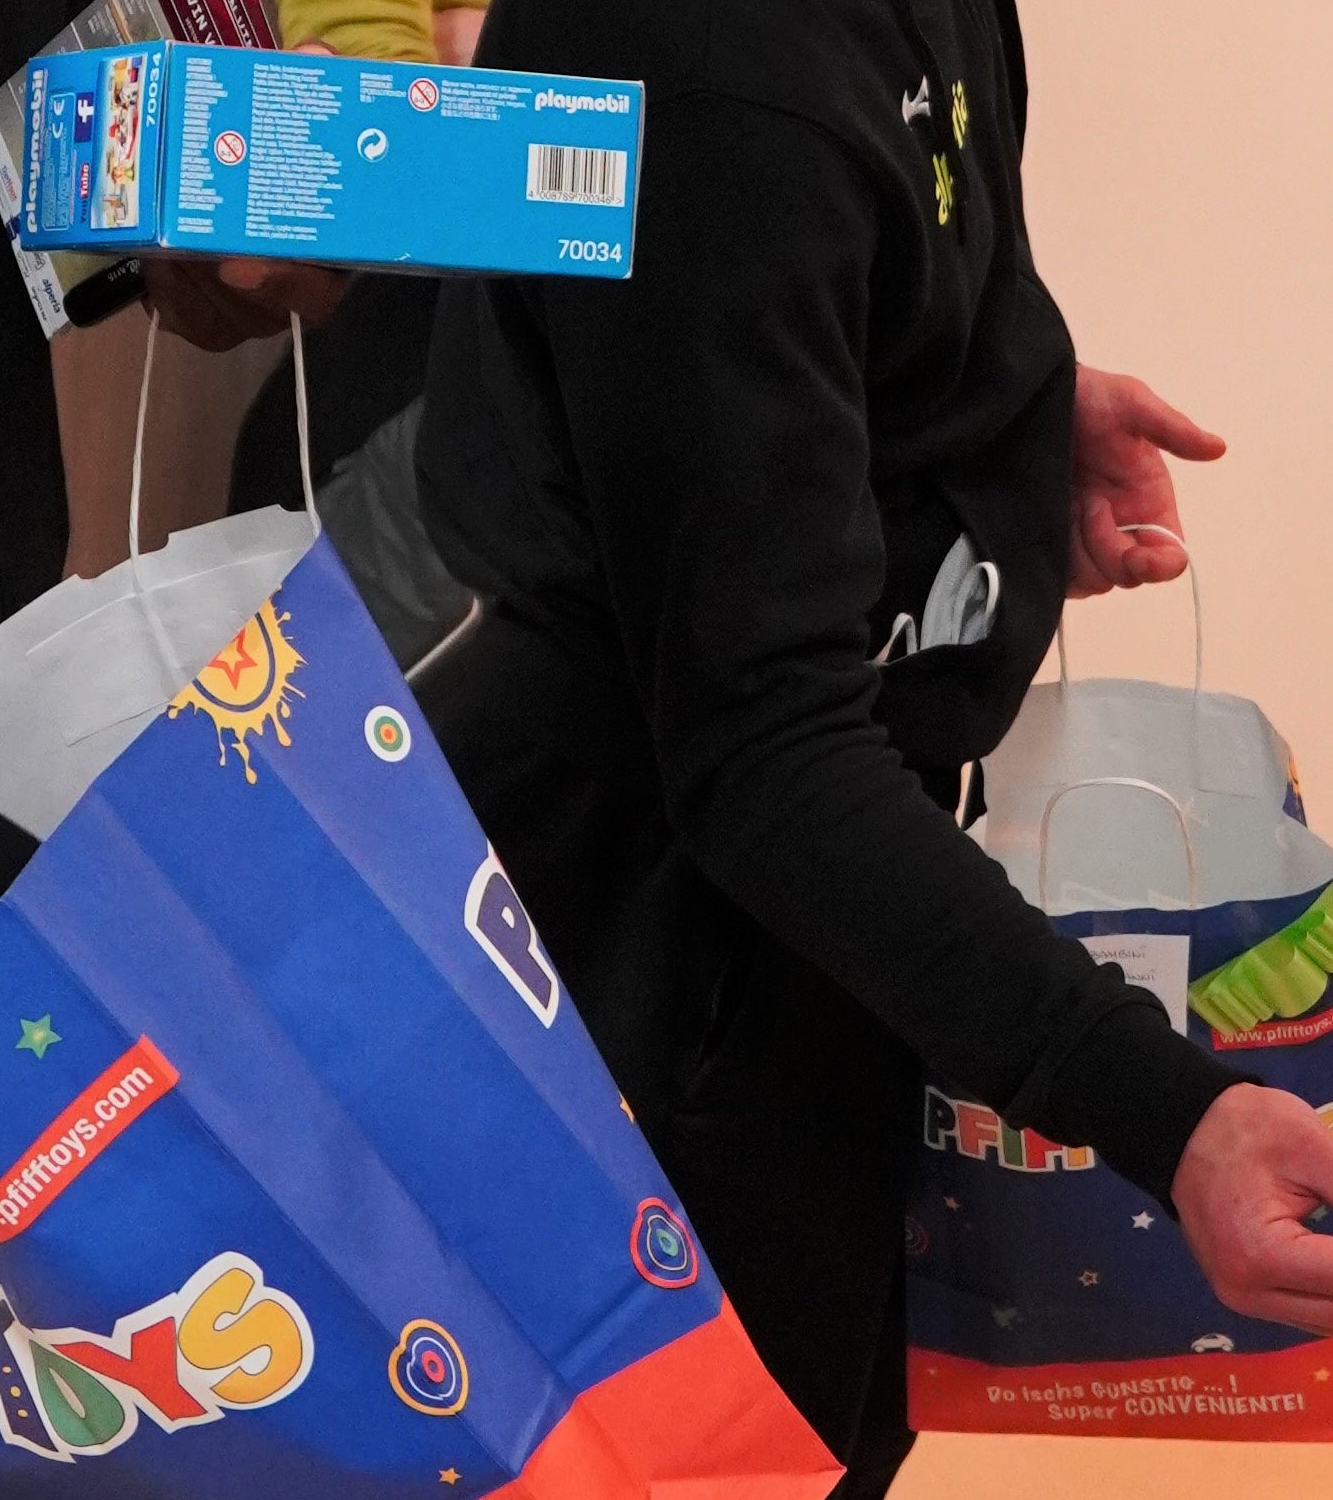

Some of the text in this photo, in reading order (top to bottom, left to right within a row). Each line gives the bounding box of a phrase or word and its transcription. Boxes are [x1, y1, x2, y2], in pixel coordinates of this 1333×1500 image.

[146, 51, 162, 128] 70034
[534, 88, 630, 114] playmobil
[26, 69, 43, 233] playmobil
[557, 239, 623, 263] 70034
[41, 277, 62, 314] alperia
[986, 1385, 1016, 1404] Do
[1047, 1393, 1305, 1422] Super CONVENIENTE!
